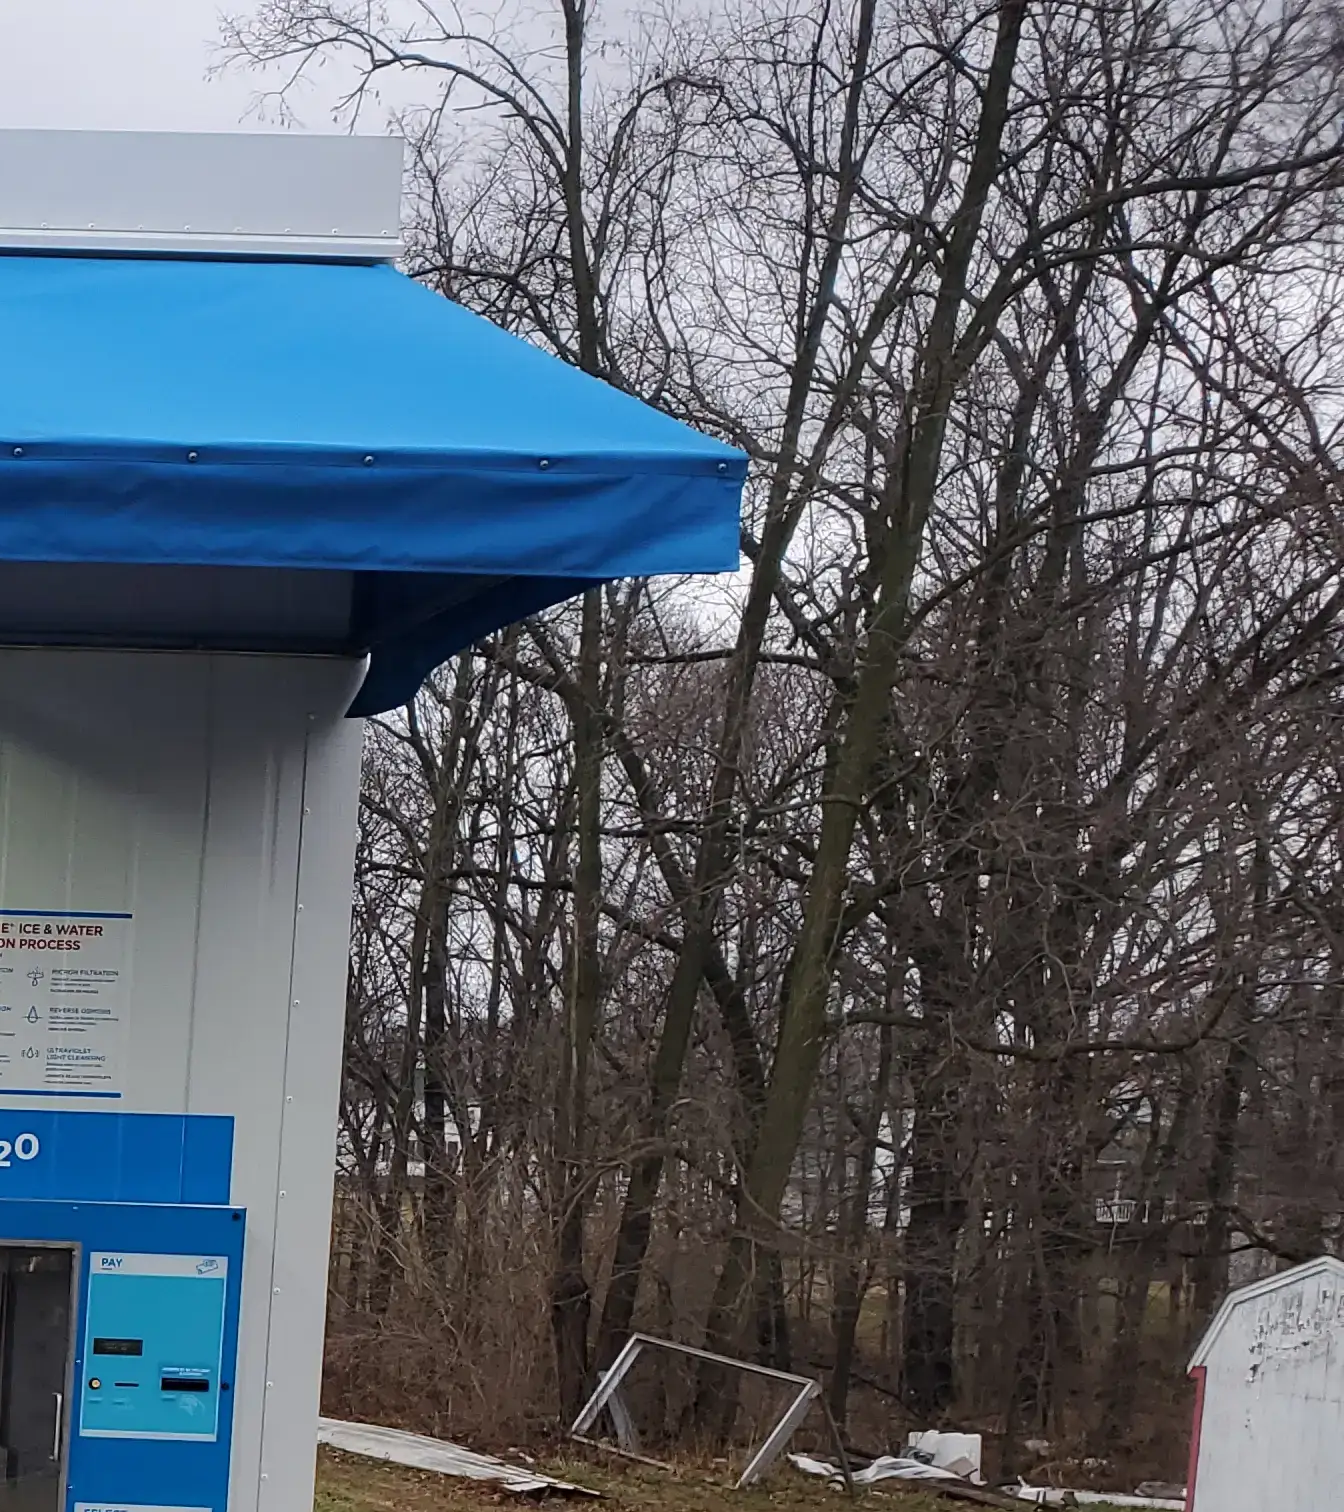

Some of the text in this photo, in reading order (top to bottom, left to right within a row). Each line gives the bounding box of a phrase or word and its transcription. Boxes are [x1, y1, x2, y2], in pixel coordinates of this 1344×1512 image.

[19, 924, 41, 934] ICE
[44, 925, 52, 935] &
[55, 925, 104, 936] WATER
[20, 940, 81, 950] PROCESS
[101, 1258, 122, 1268] PAY
